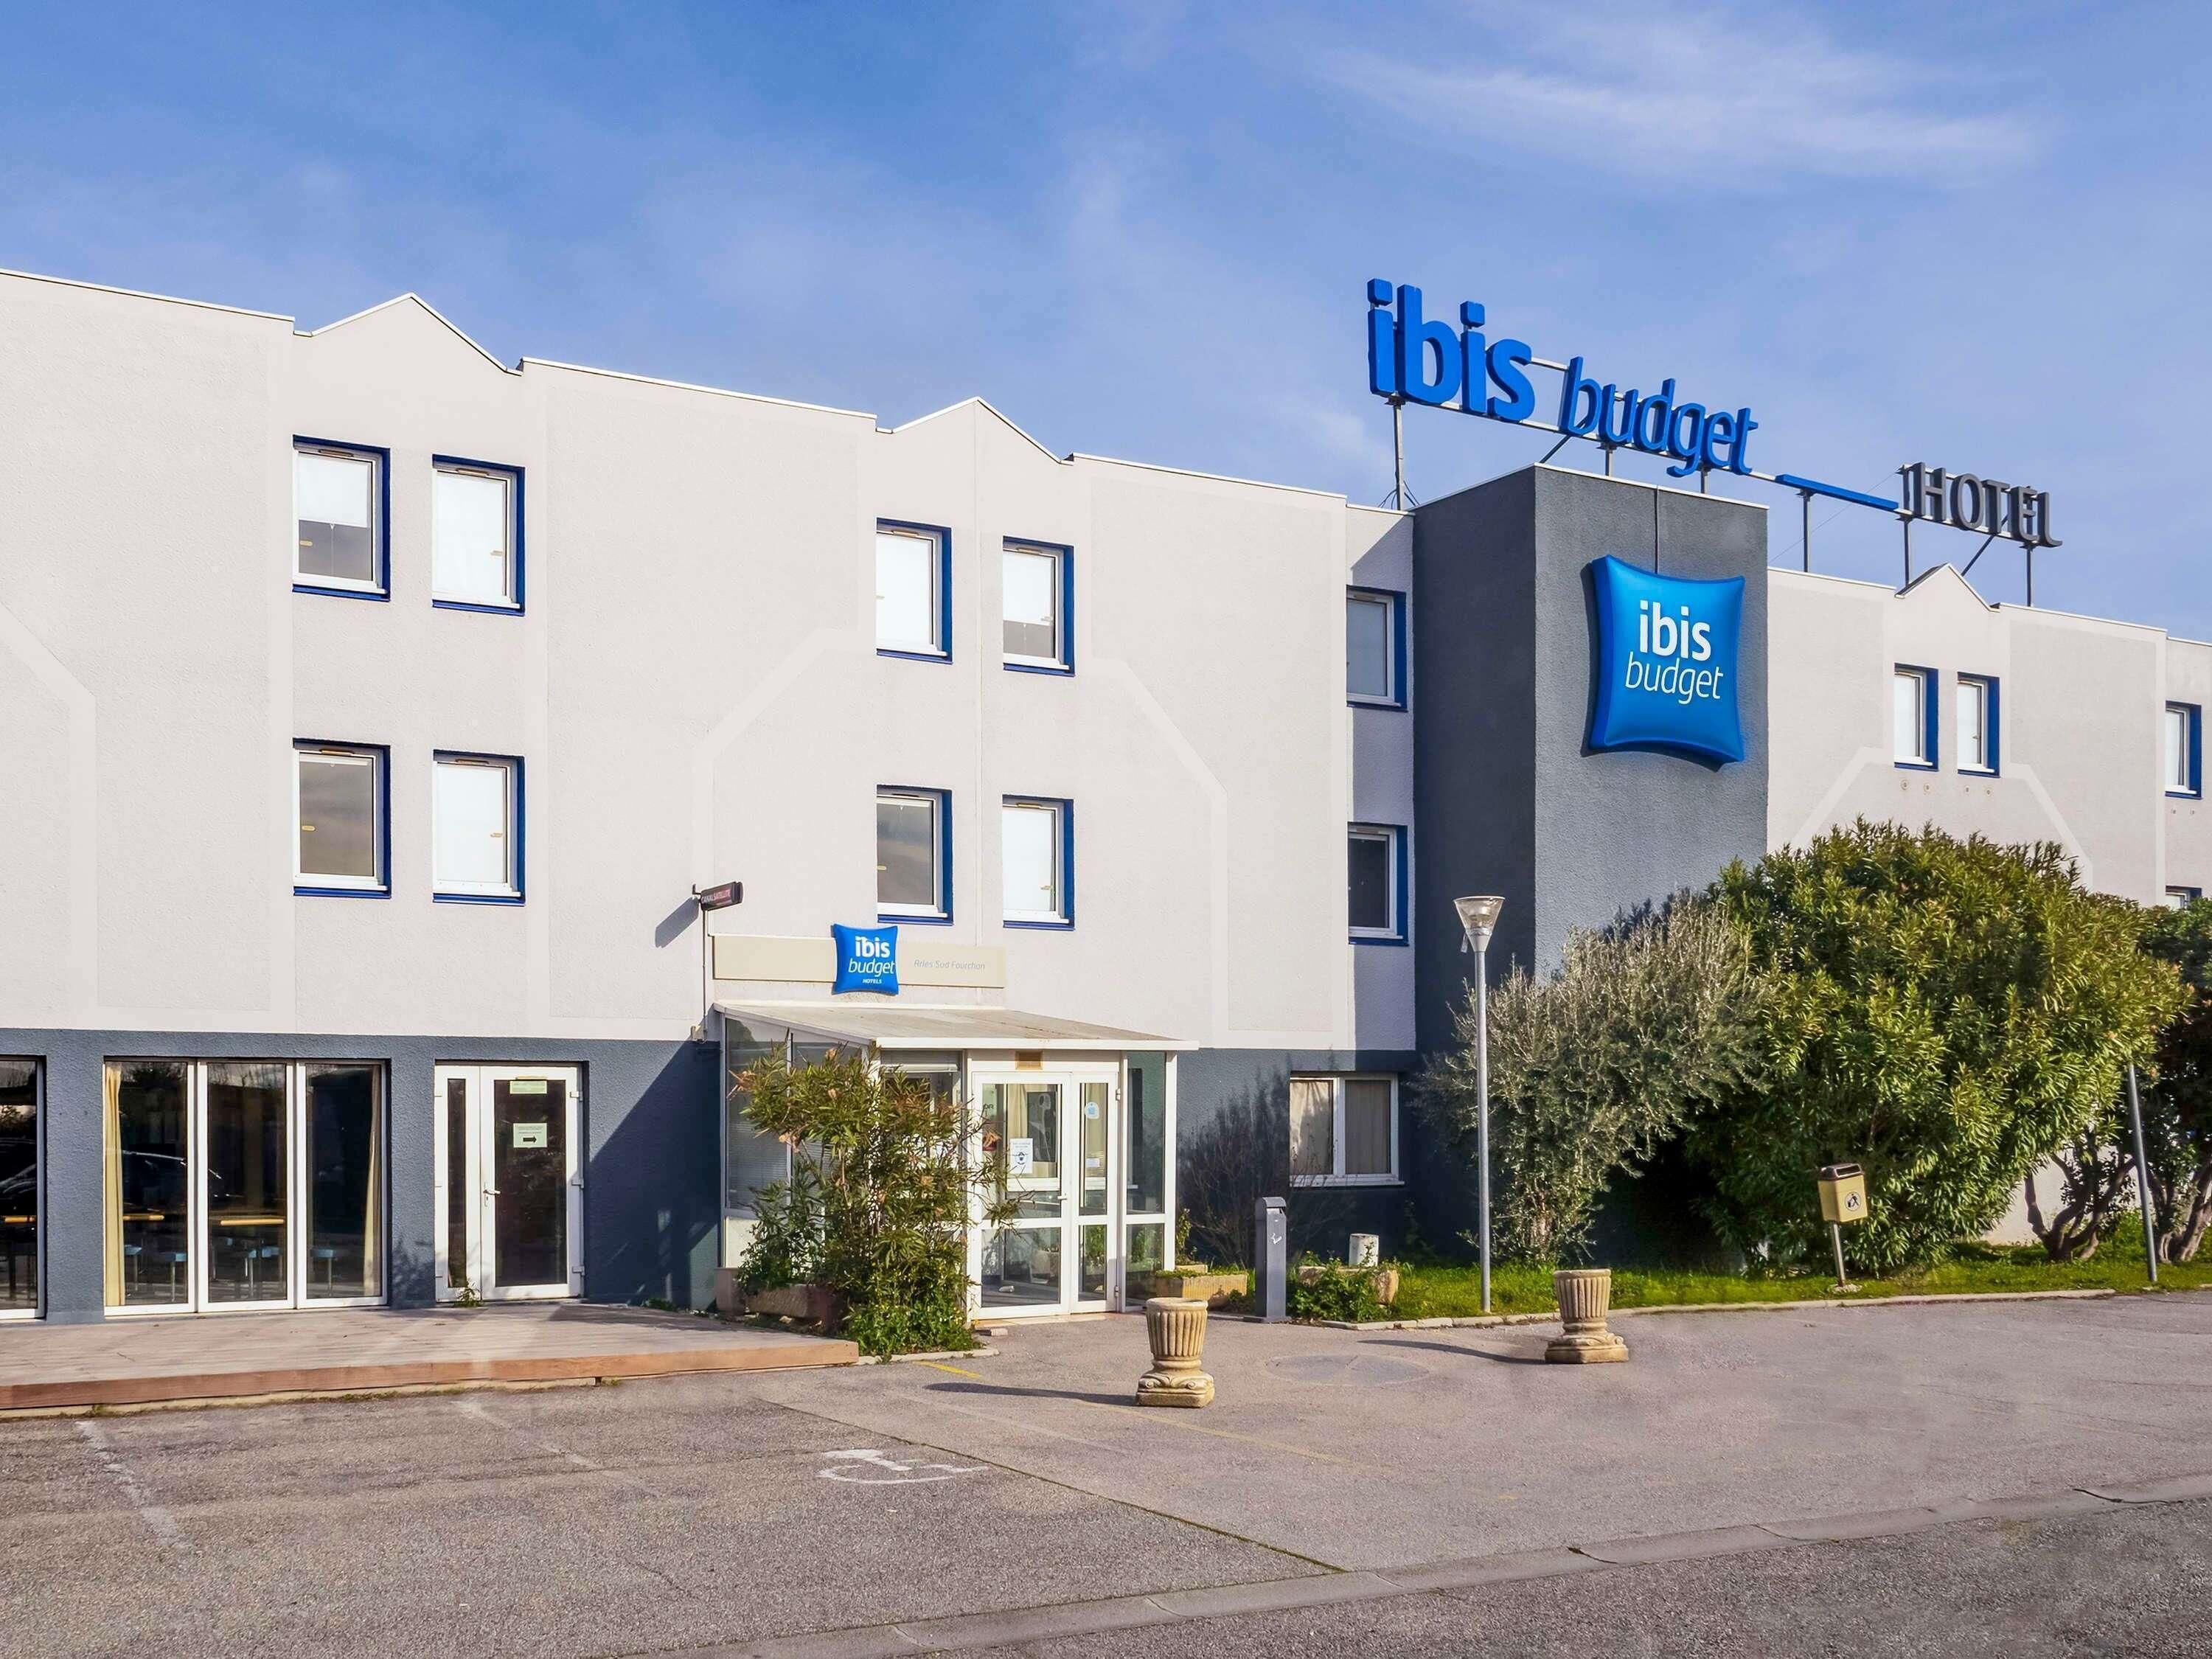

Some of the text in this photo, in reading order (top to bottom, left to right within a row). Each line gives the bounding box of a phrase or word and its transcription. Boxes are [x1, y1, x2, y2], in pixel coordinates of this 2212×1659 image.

[1367, 278, 1759, 478] ibis budget
[1913, 461, 2063, 548] HOTEL
[1624, 599, 1724, 705] ibis budget
[847, 935, 895, 978] ibis budget
